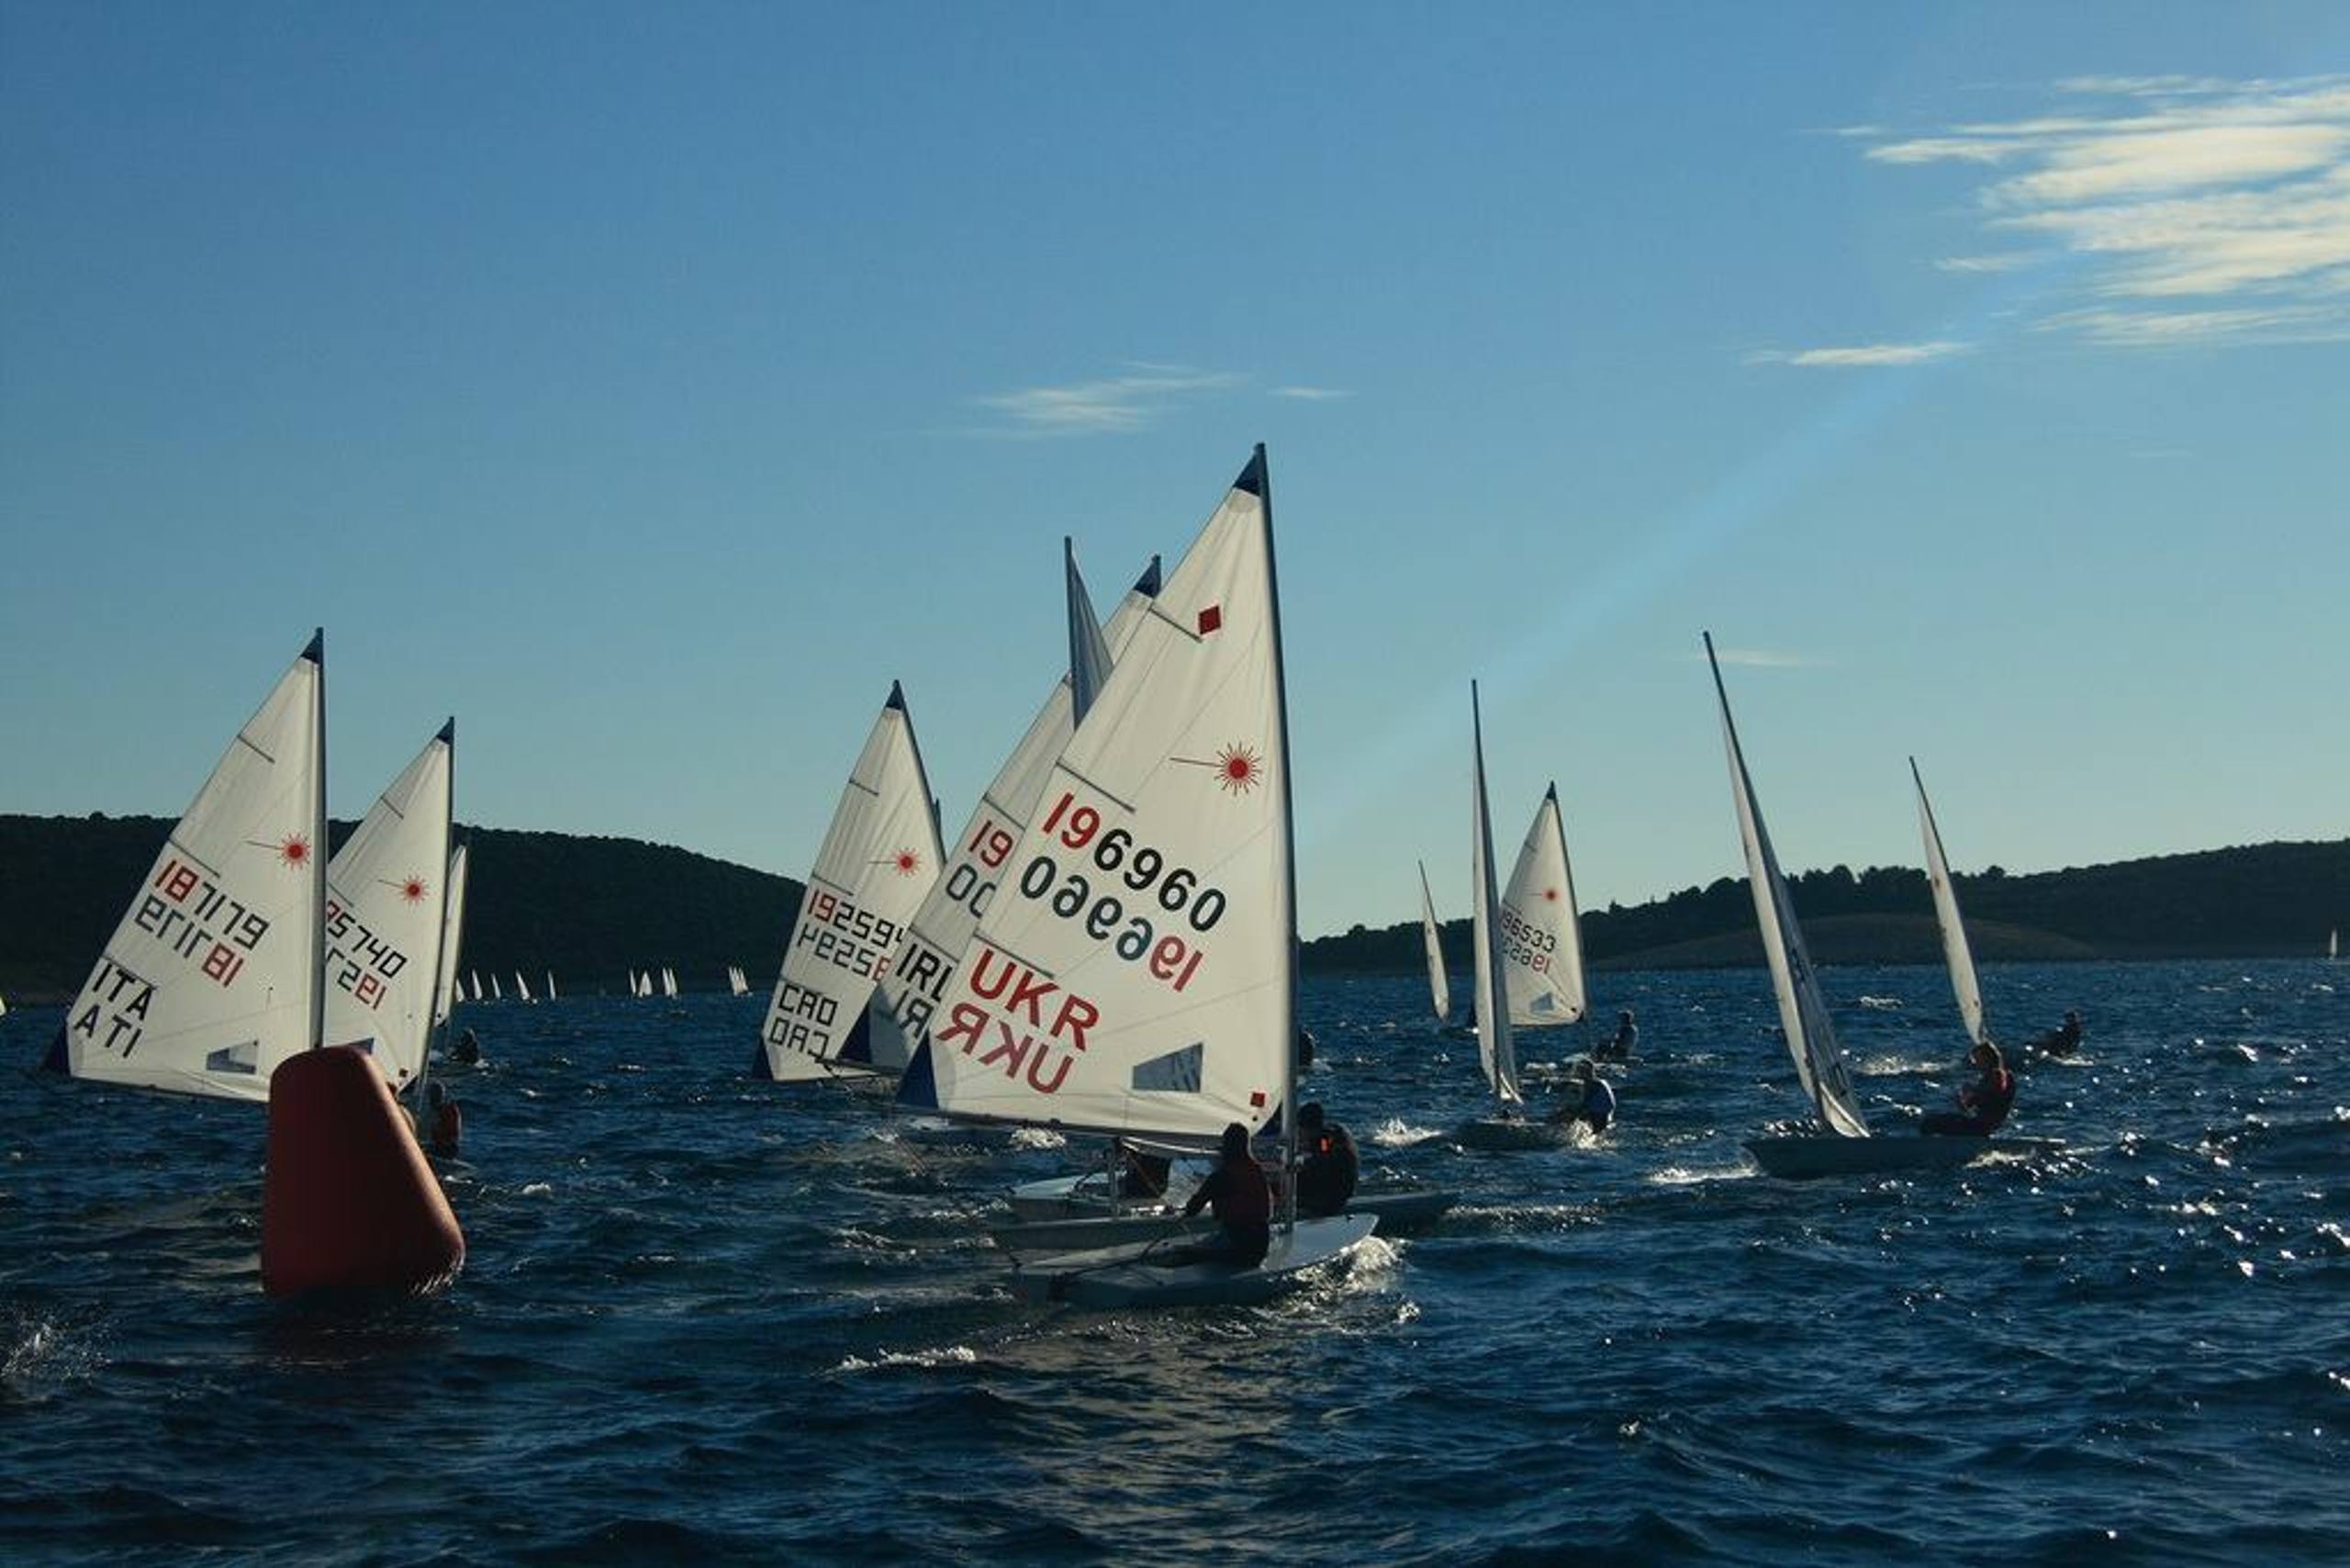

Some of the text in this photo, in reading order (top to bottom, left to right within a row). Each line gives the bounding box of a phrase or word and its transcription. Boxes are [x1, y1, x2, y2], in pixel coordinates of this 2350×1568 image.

[154, 859, 270, 950] 187179
[1041, 792, 1226, 933] 196960
[92, 964, 157, 1021] ITA
[896, 943, 953, 1002] IRL
[969, 948, 1100, 1051] UKR
